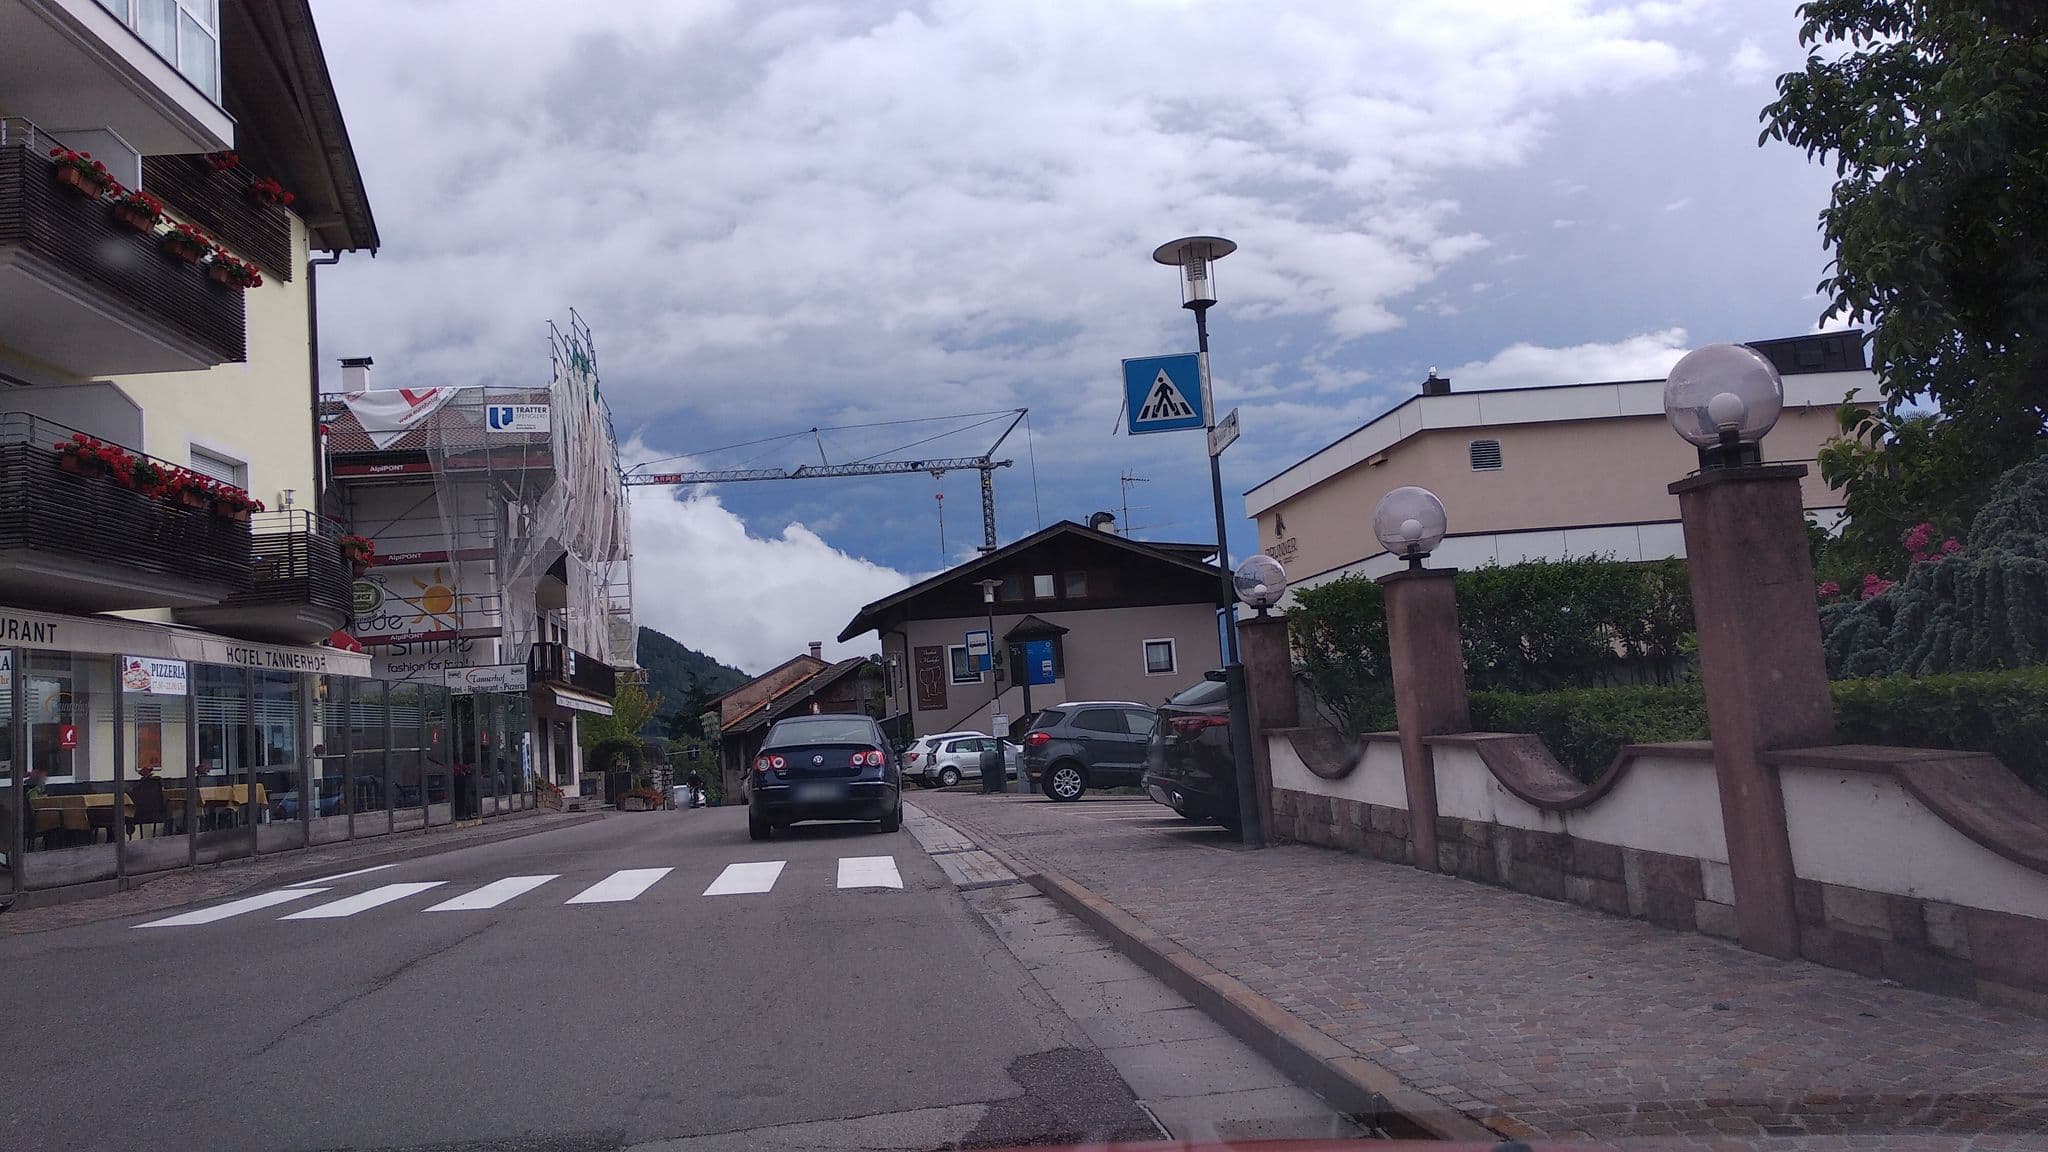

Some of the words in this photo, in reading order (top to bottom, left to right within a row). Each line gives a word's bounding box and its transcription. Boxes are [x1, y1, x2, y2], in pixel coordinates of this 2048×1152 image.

[226, 647, 262, 666] HOTEL
[151, 663, 185, 679] PIZZERIA
[387, 662, 425, 673] fashion
[428, 660, 442, 671] for
[503, 682, 526, 690] Pizzeria
